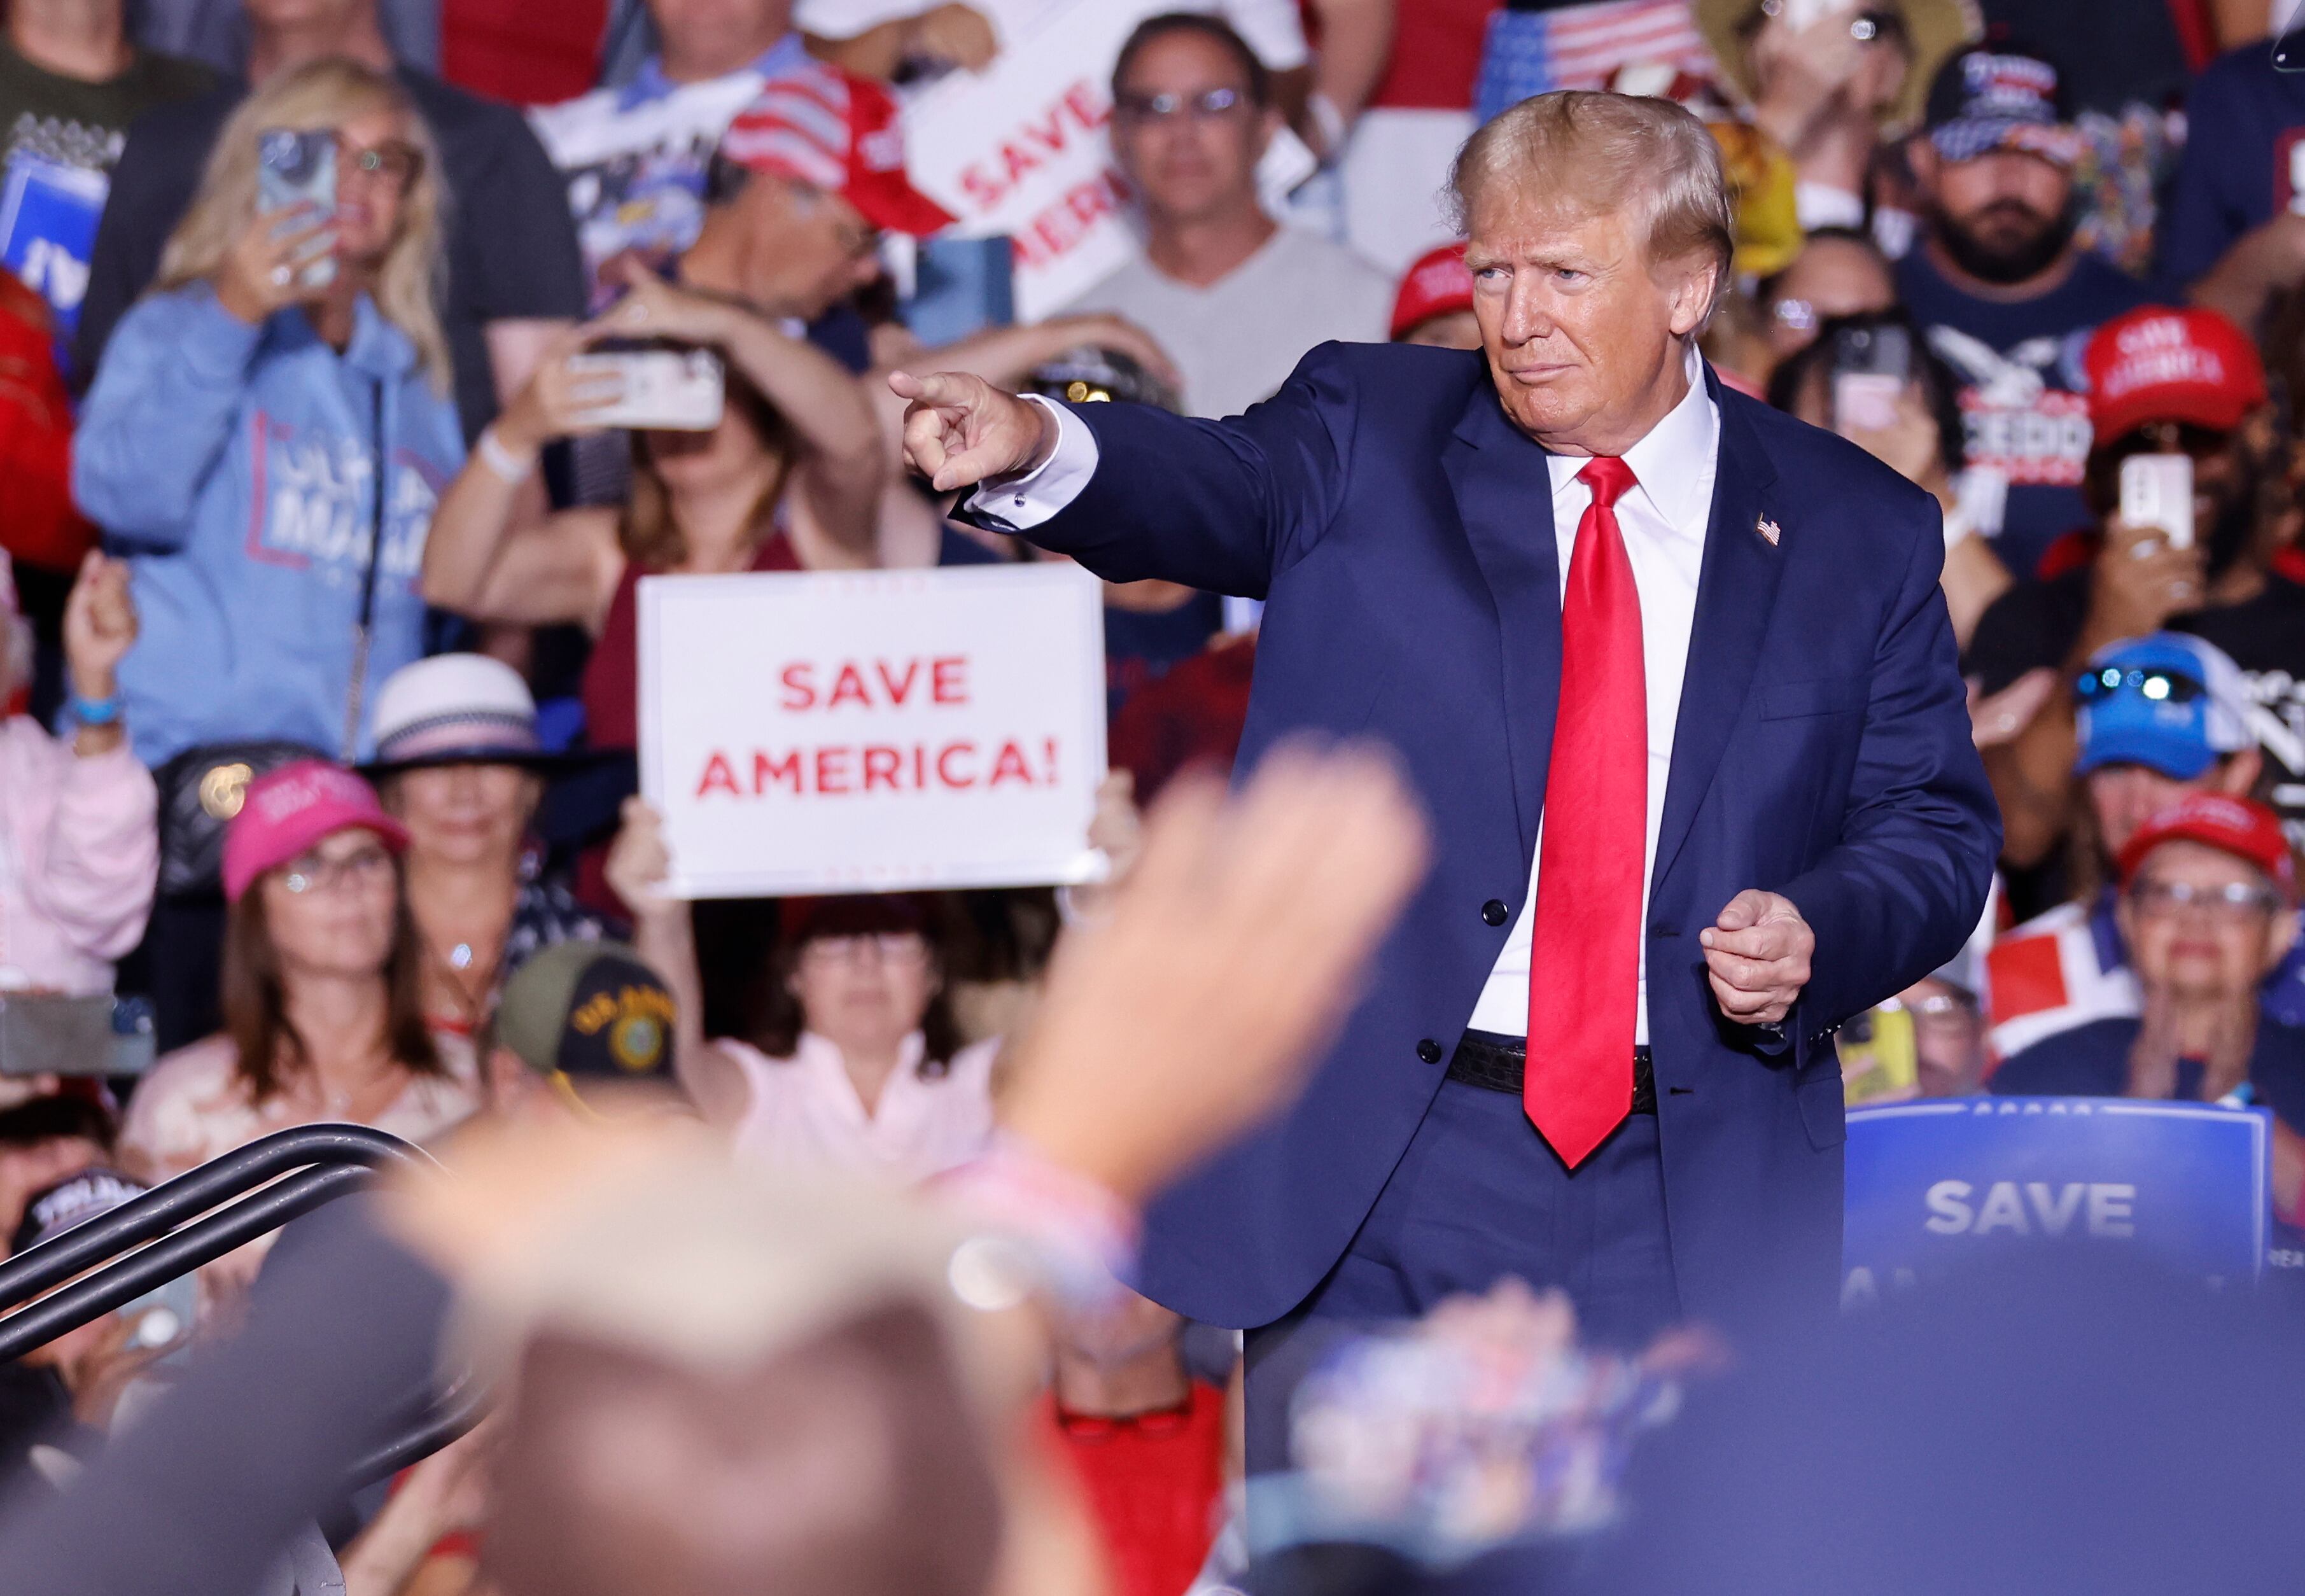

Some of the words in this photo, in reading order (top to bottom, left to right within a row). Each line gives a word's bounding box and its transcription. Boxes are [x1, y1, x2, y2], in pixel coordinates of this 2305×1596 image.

[960, 80, 1114, 213] SAVE
[779, 655, 970, 711] SAVE
[695, 738, 1059, 799] AMERICA!
[1924, 1180, 2136, 1238] SAVE
